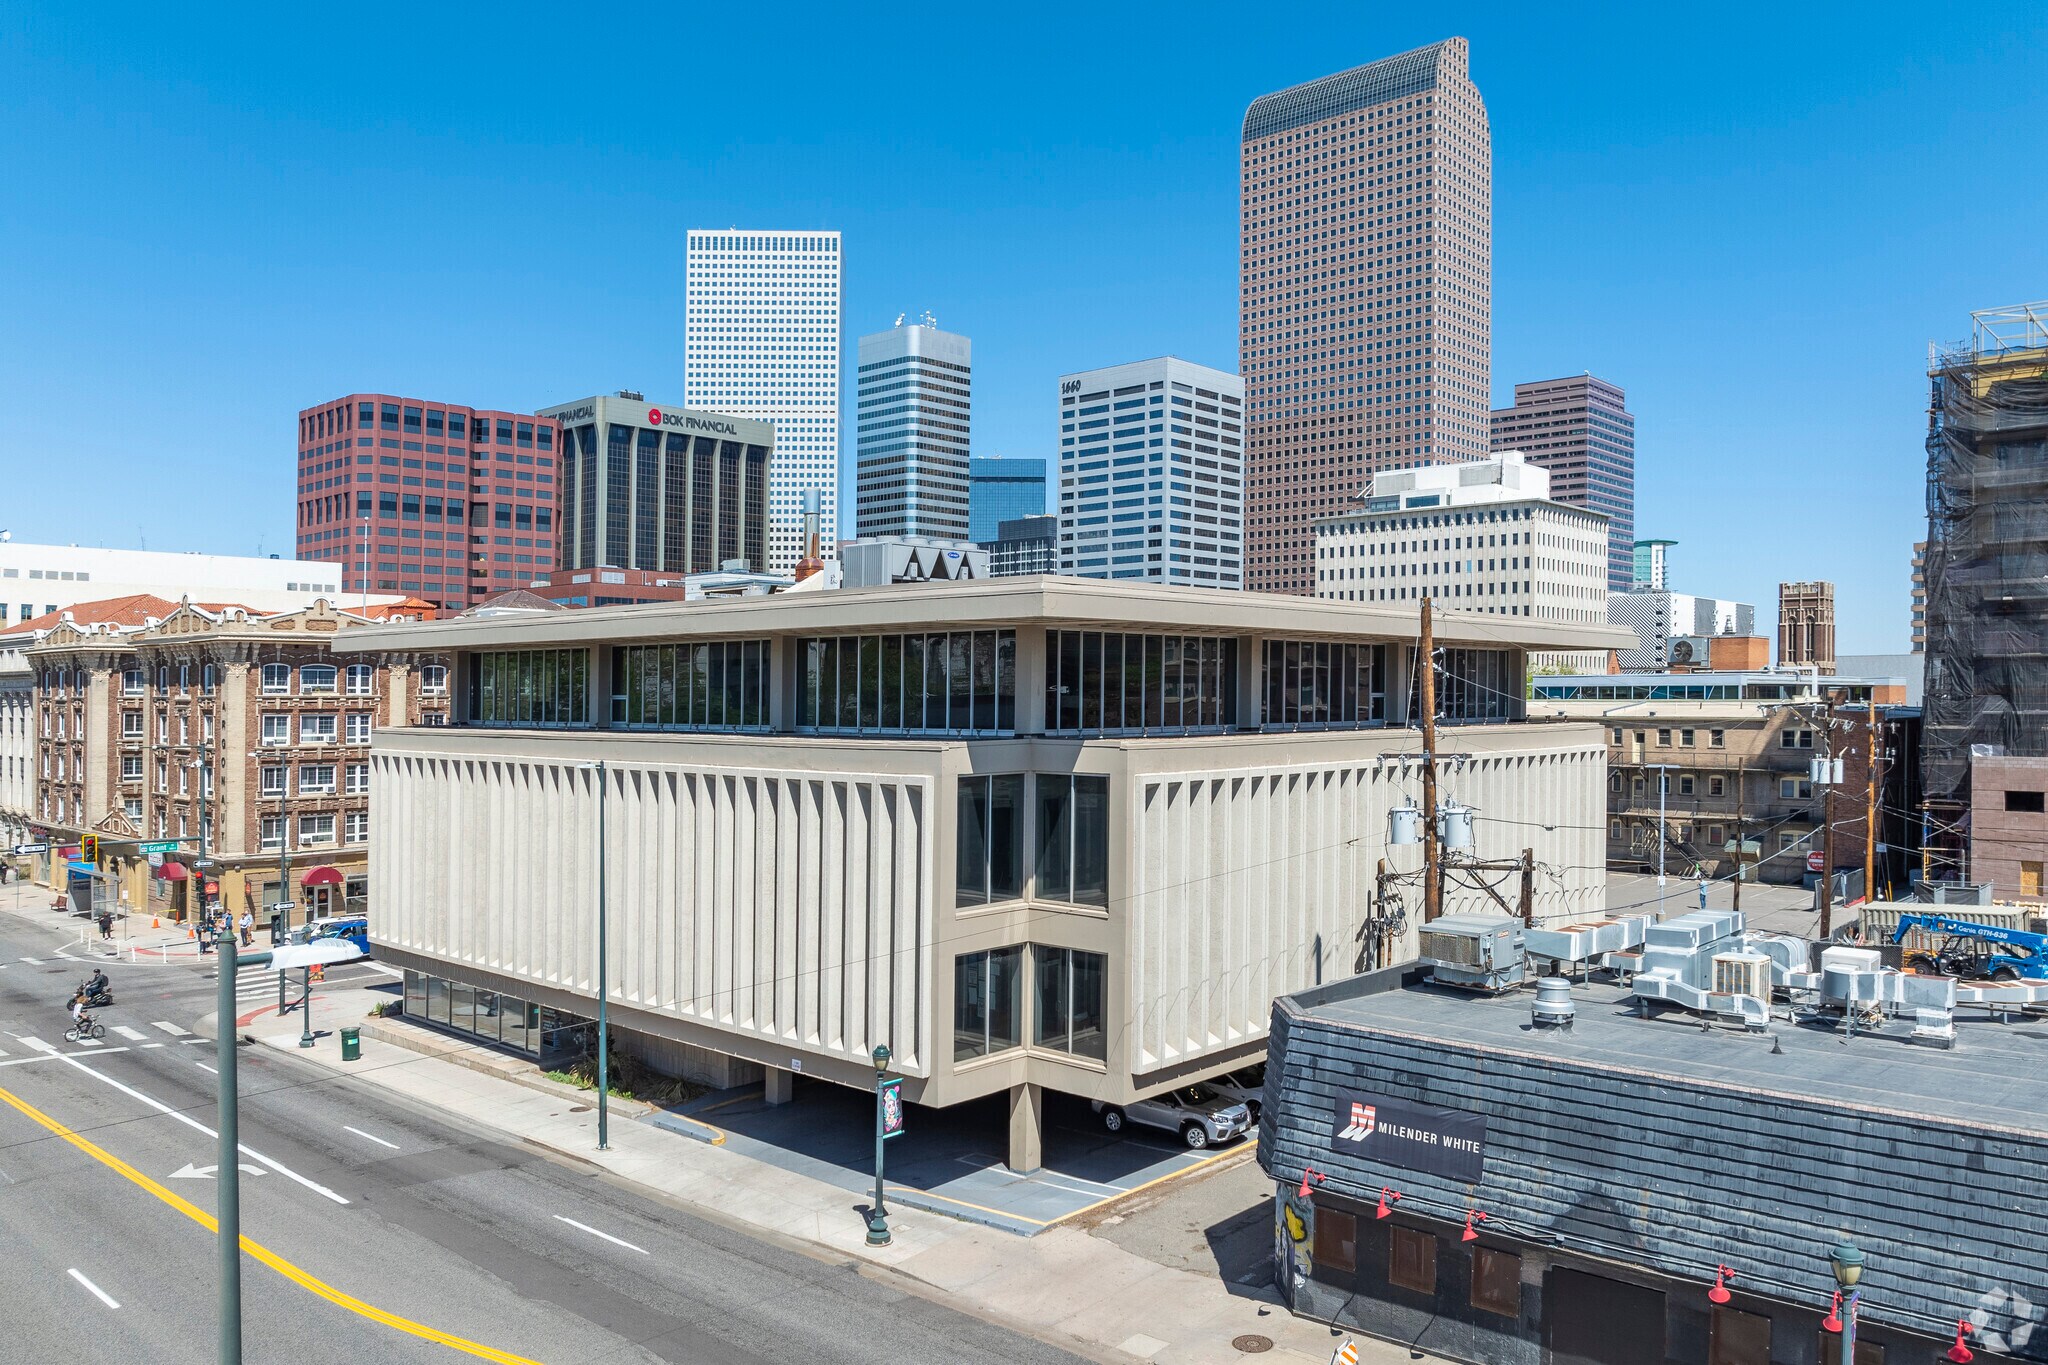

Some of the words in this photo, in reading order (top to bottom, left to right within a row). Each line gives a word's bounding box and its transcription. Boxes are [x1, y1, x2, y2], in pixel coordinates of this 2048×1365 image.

[1062, 379, 1081, 394] 1660
[662, 413, 683, 427] BOK
[686, 417, 737, 435] FINANCIAL
[148, 844, 167, 852] Grant
[1958, 925, 1977, 934] Genie
[1977, 928, 2009, 939] GTH-636
[1378, 1121, 1438, 1145] MILENDER
[1442, 1135, 1480, 1154] WHITE
